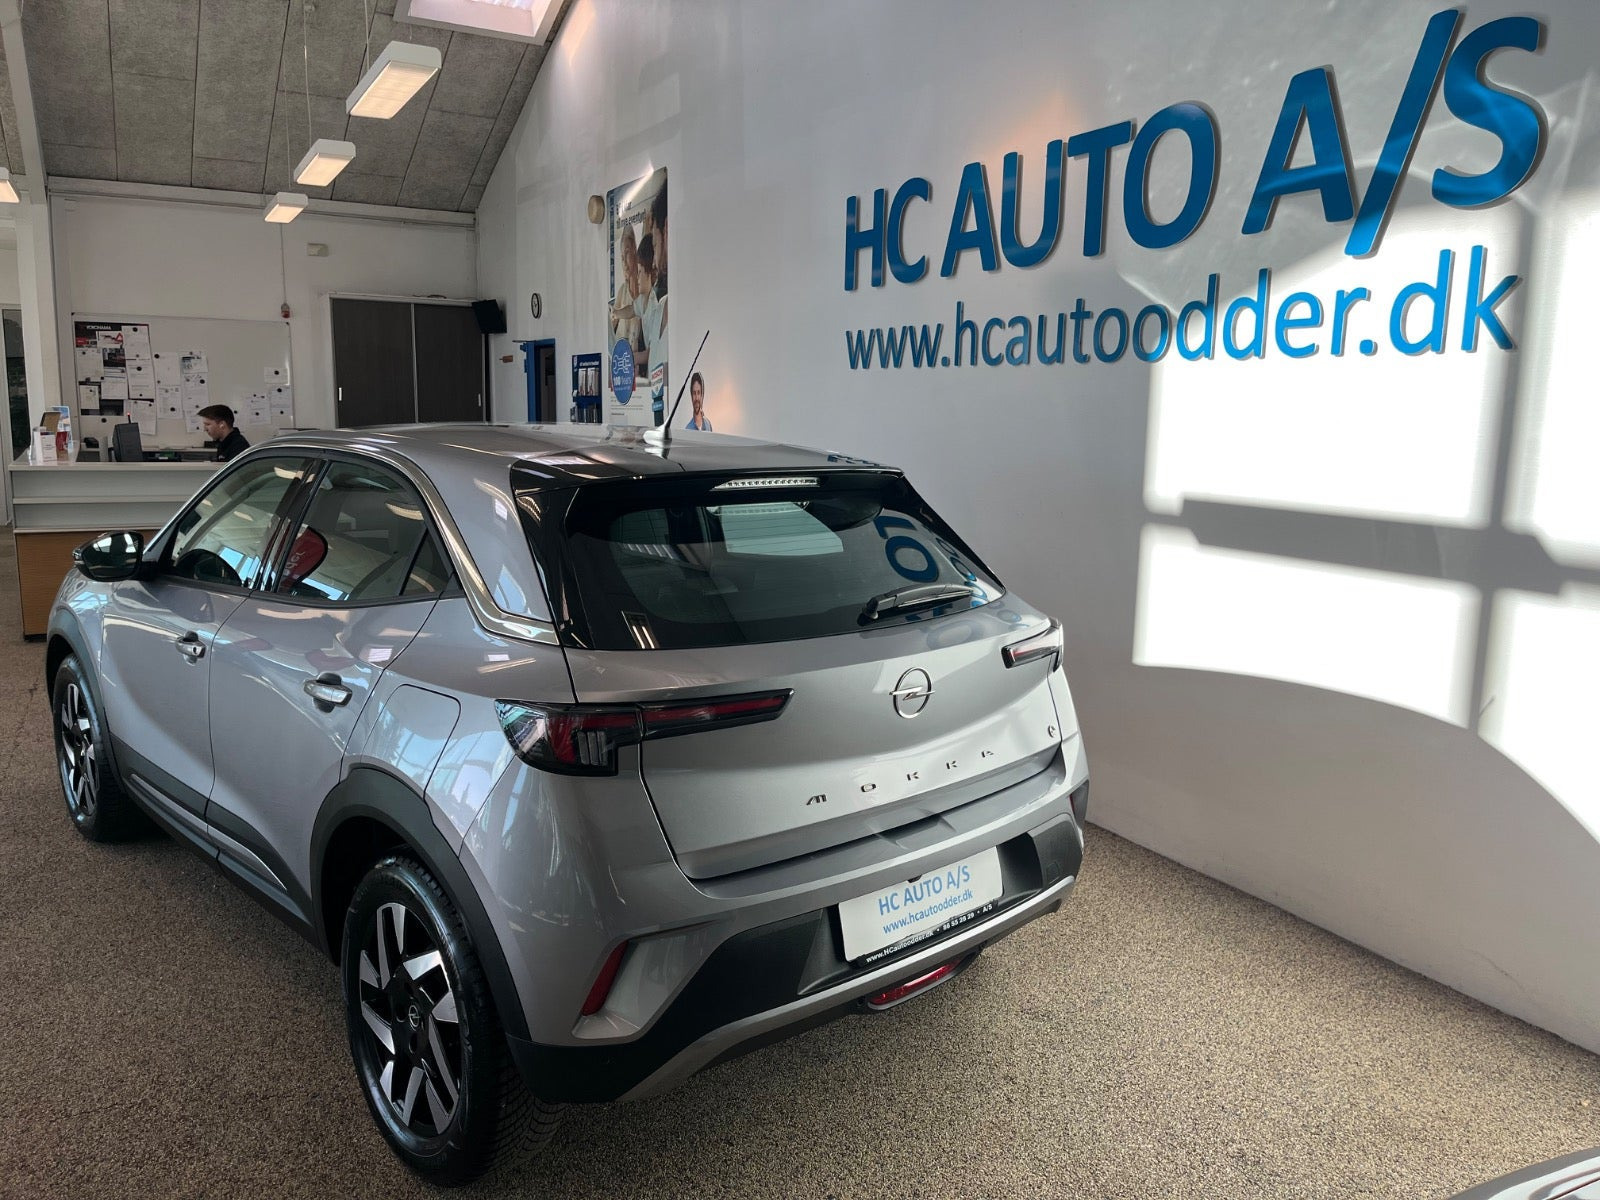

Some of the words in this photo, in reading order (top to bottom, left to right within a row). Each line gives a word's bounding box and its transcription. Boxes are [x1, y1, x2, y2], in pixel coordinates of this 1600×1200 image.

[844, 177, 931, 291] HC
[941, 101, 1219, 279] AUTO
[1241, 8, 1543, 258] A/S
[846, 244, 1522, 371] www.hcautoodder.dk
[806, 750, 994, 806] MOKKA
[878, 893, 900, 916] HC
[903, 876, 943, 907] AUTO
[946, 865, 970, 890] A/S
[882, 888, 973, 935] www.hcautoodder.dk
[982, 903, 993, 913] A/S
